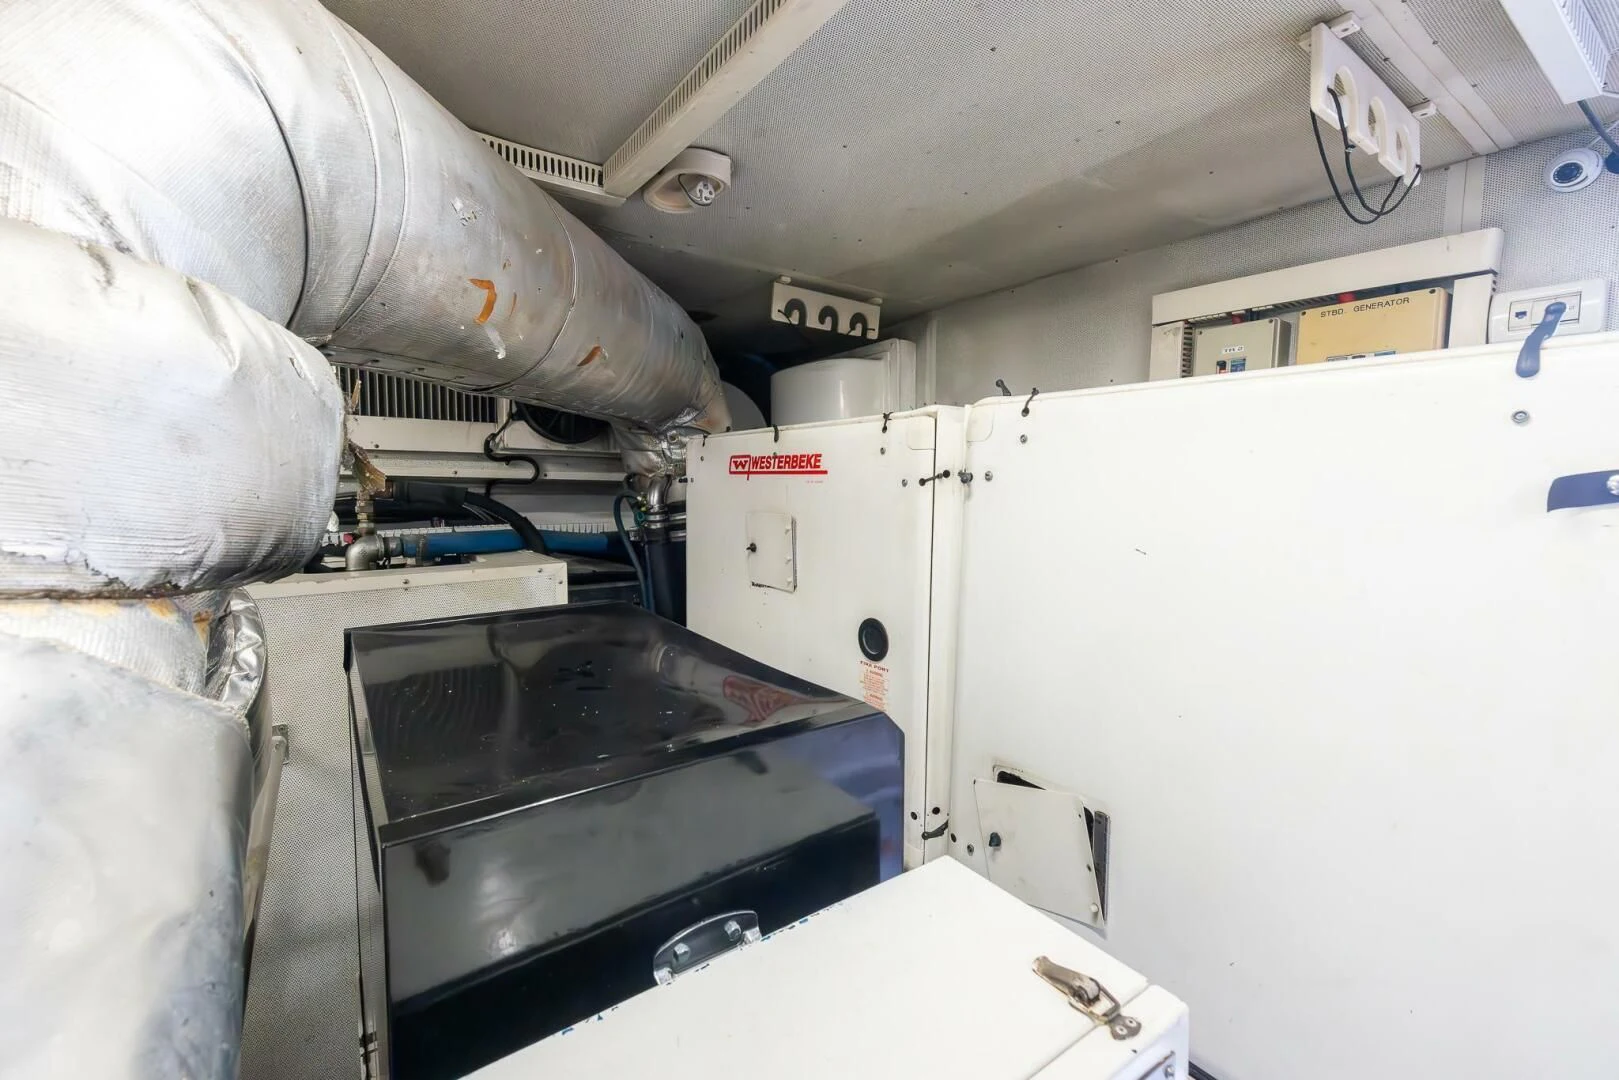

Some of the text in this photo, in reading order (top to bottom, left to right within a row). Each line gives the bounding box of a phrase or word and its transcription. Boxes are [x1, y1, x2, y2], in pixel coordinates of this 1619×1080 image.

[1353, 296, 1410, 312] GENERATOR
[751, 453, 822, 470] WESTERBEKE
[873, 664, 889, 673] PORT
